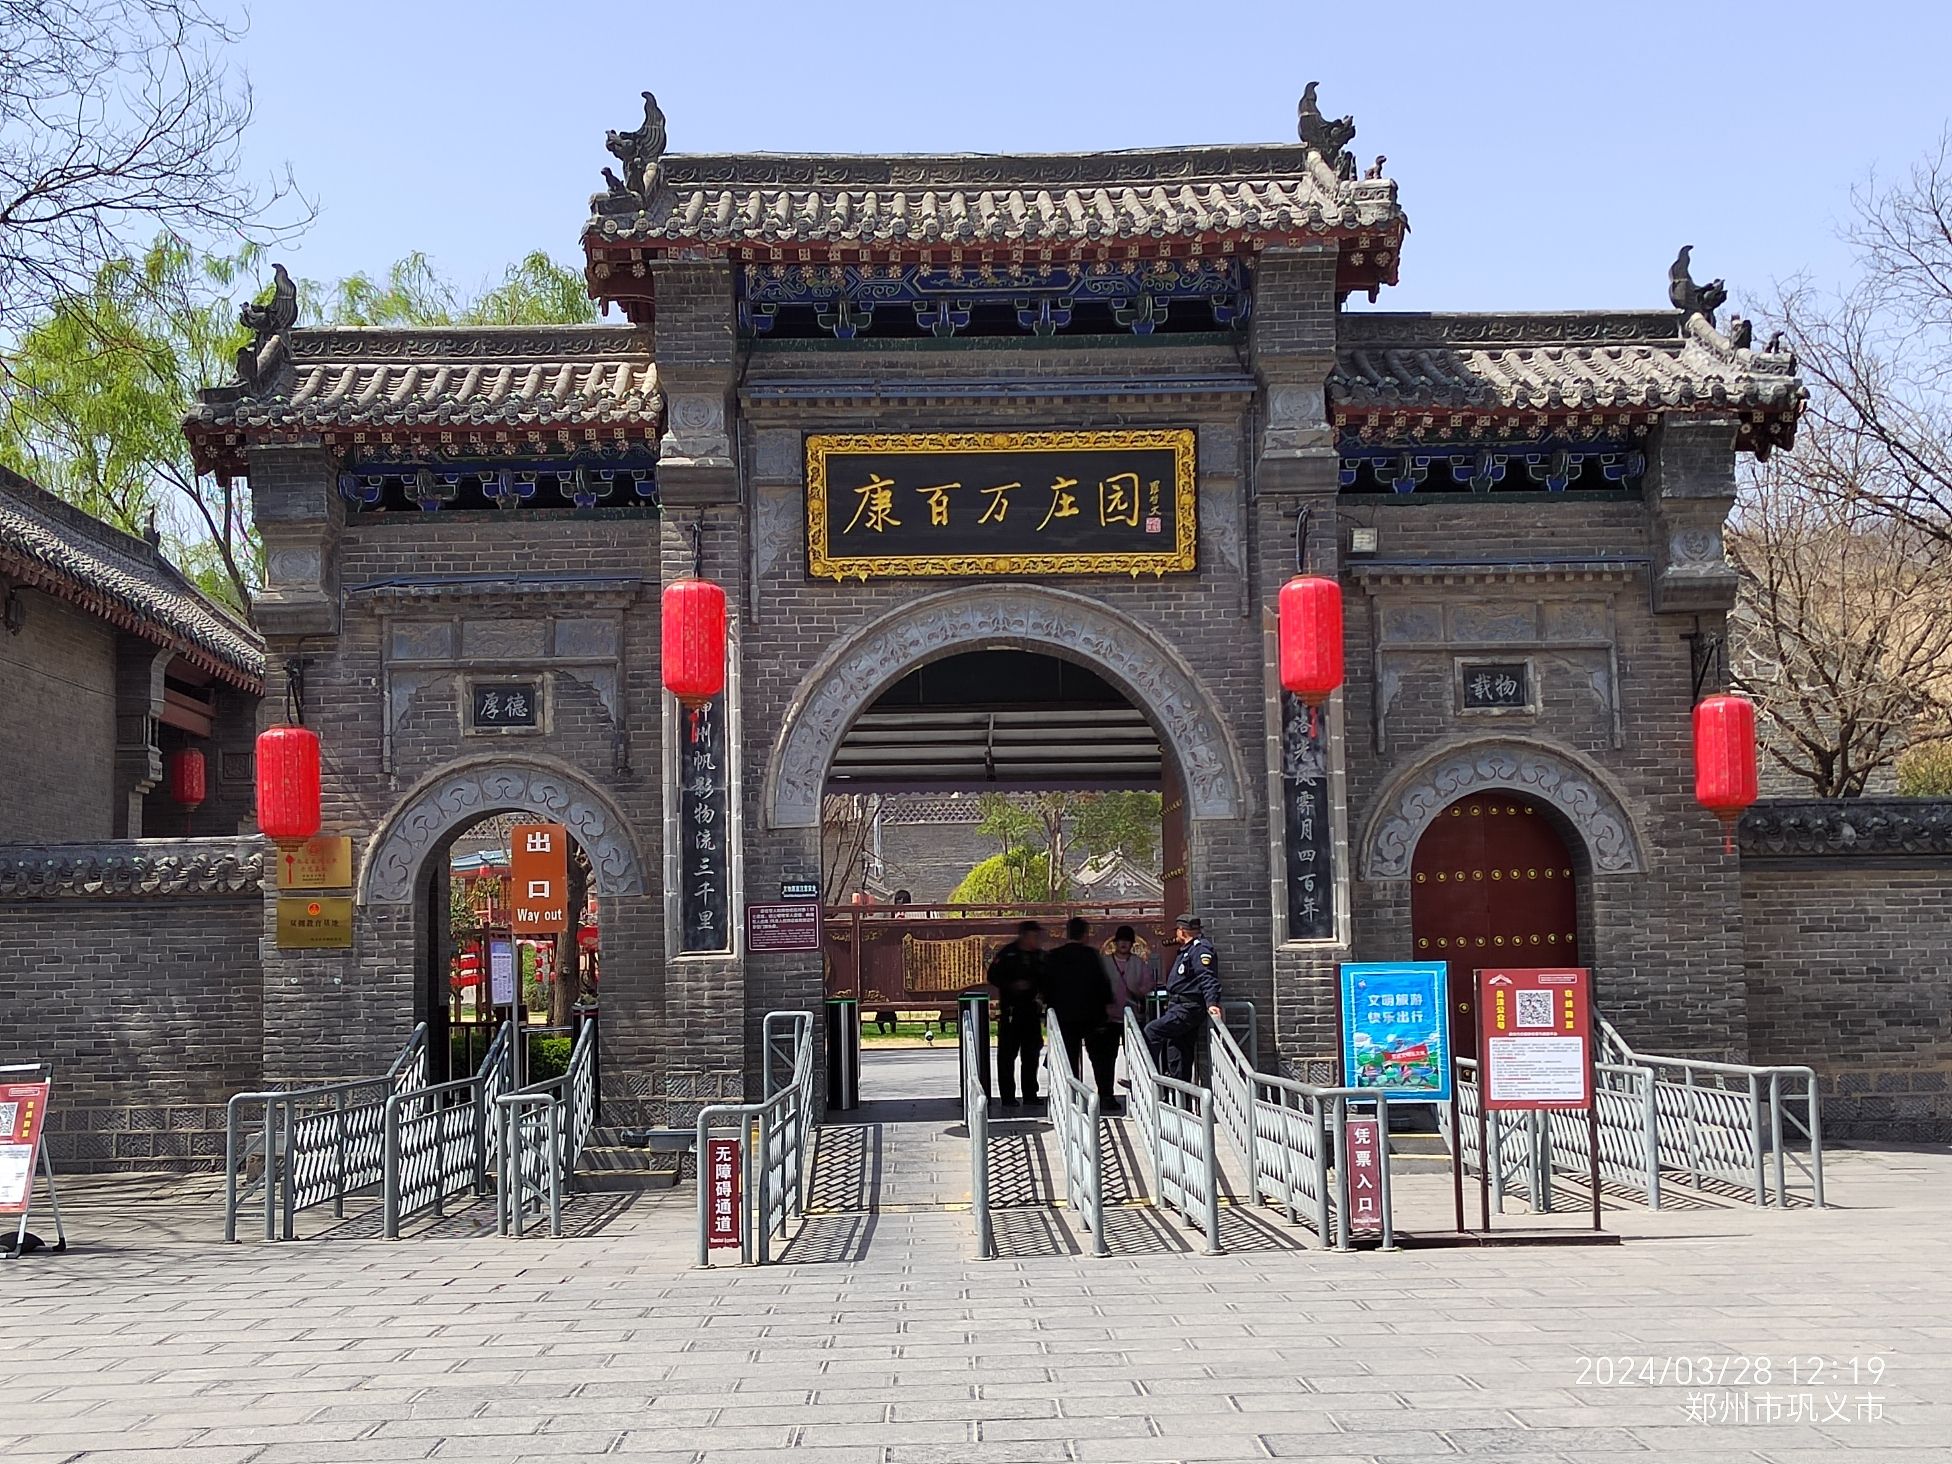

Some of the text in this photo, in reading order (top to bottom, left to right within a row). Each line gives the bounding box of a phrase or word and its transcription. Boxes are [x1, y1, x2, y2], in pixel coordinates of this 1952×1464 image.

[843, 472, 1140, 534] 康百万庄园
[480, 692, 529, 719] 厚德
[527, 832, 551, 899] 出口
[517, 908, 563, 924] Way out
[1367, 1010, 1424, 1024] 快乐出行
[715, 1146, 732, 1232] 无障碍通道
[1354, 1127, 1373, 1212] 凭票入口
